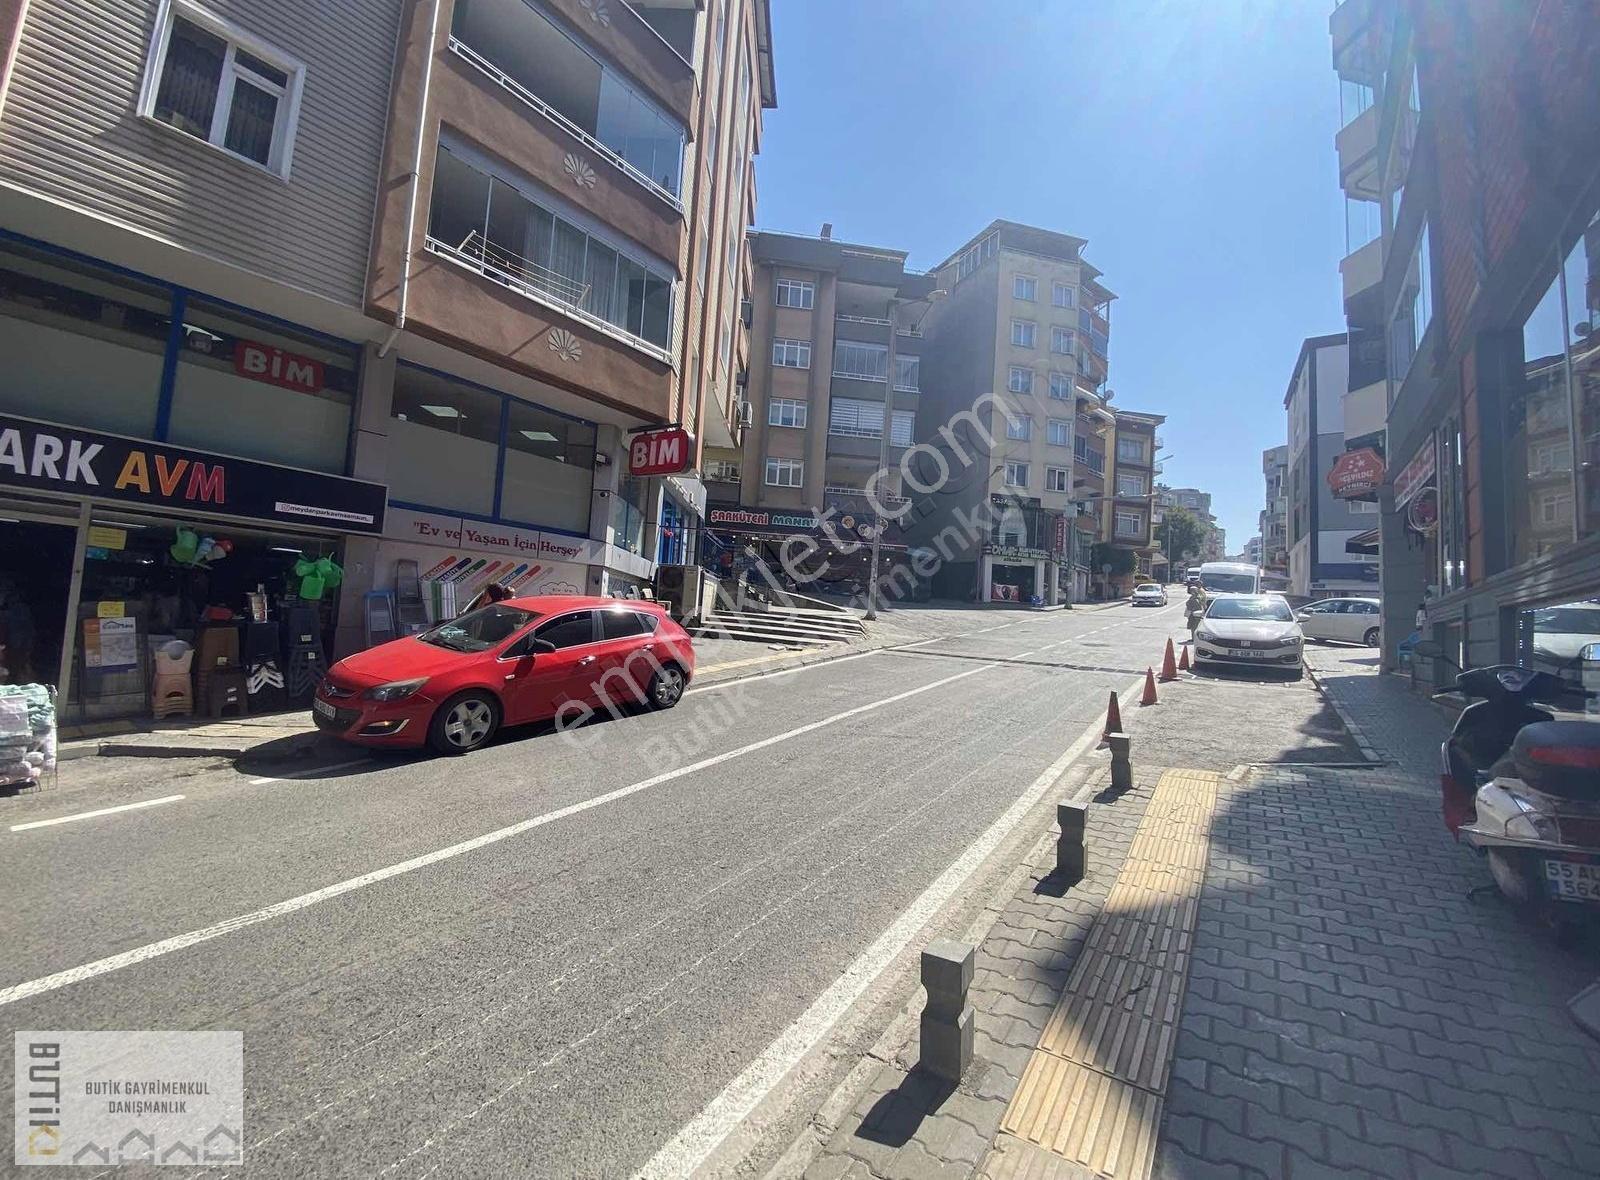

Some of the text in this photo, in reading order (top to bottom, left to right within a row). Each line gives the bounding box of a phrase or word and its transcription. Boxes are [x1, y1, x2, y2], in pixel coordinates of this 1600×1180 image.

[243, 347, 315, 388] BİM
[0, 428, 225, 504] ARK AVM
[632, 433, 680, 469] BİM
[444, 528, 461, 540] ve
[466, 529, 509, 548] Yaşam
[514, 533, 537, 551] İçin
[1548, 862, 1574, 878] 55
